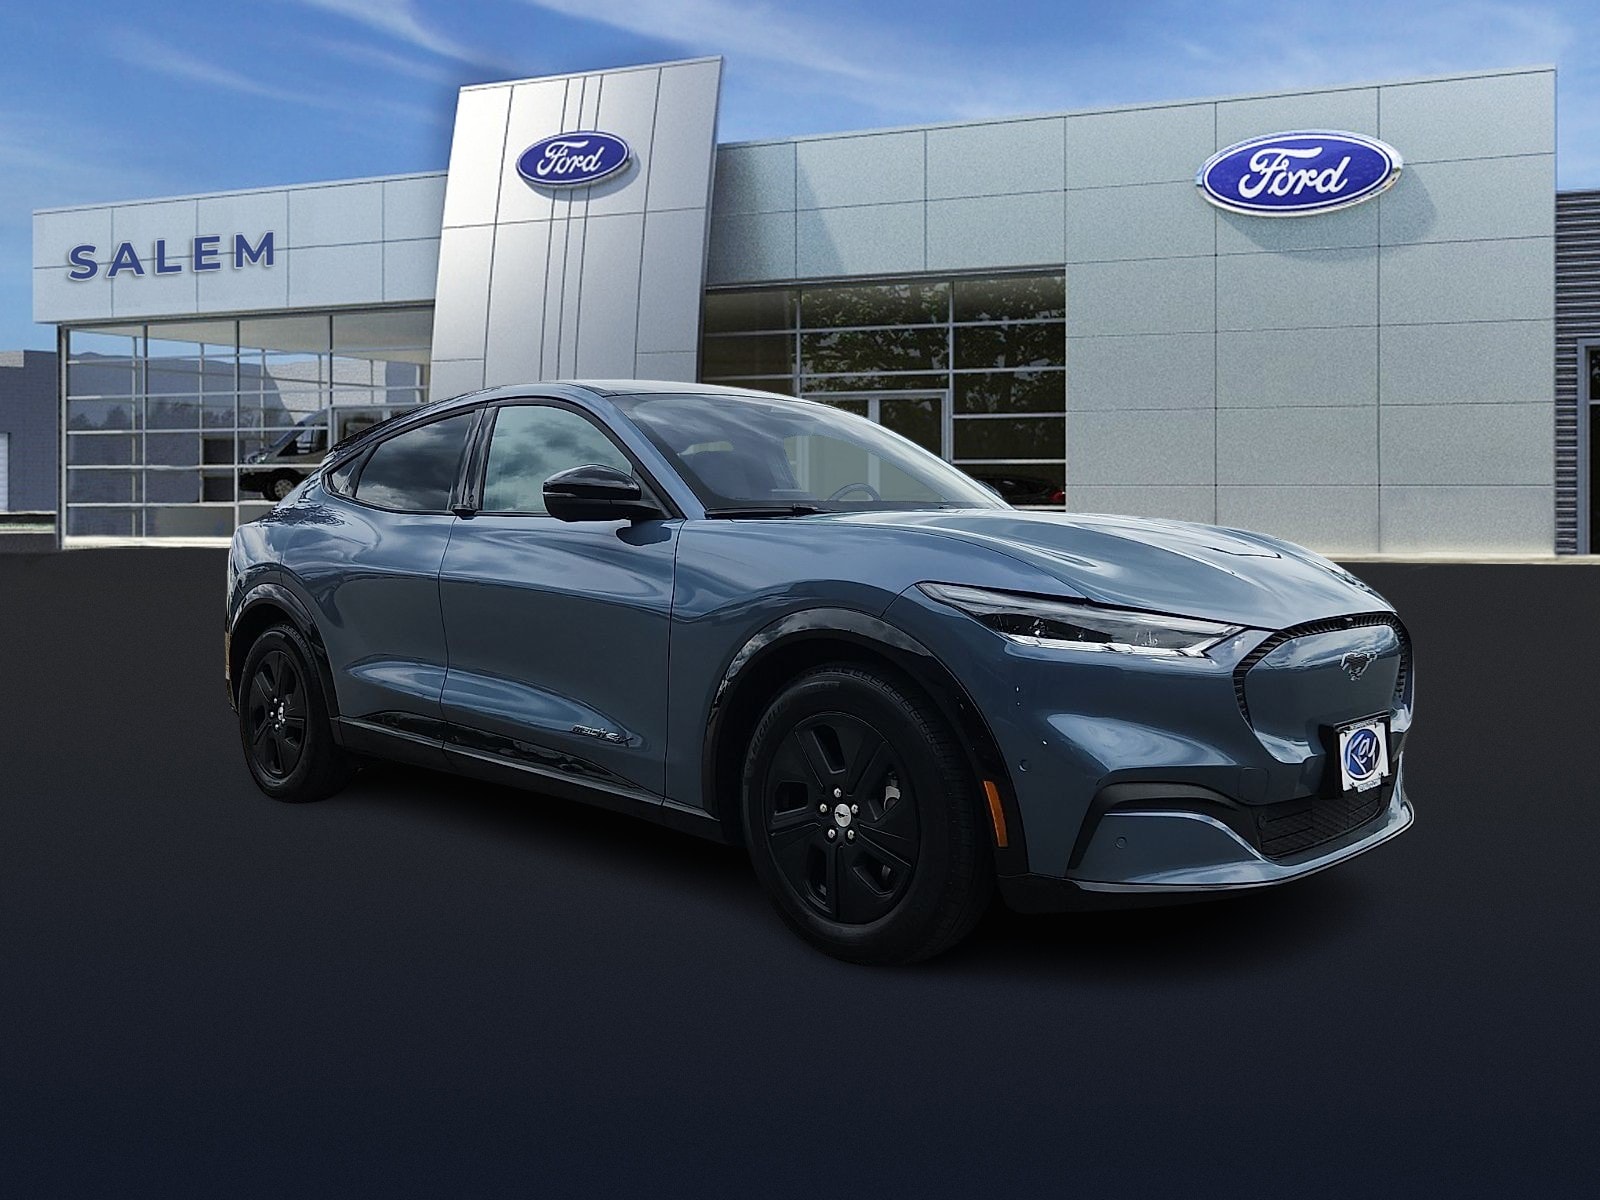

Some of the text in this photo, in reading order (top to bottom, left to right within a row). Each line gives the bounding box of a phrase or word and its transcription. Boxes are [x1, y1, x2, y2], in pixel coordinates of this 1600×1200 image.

[537, 140, 605, 175] Ford
[1238, 147, 1351, 198] Ford
[69, 231, 274, 280] SALEM
